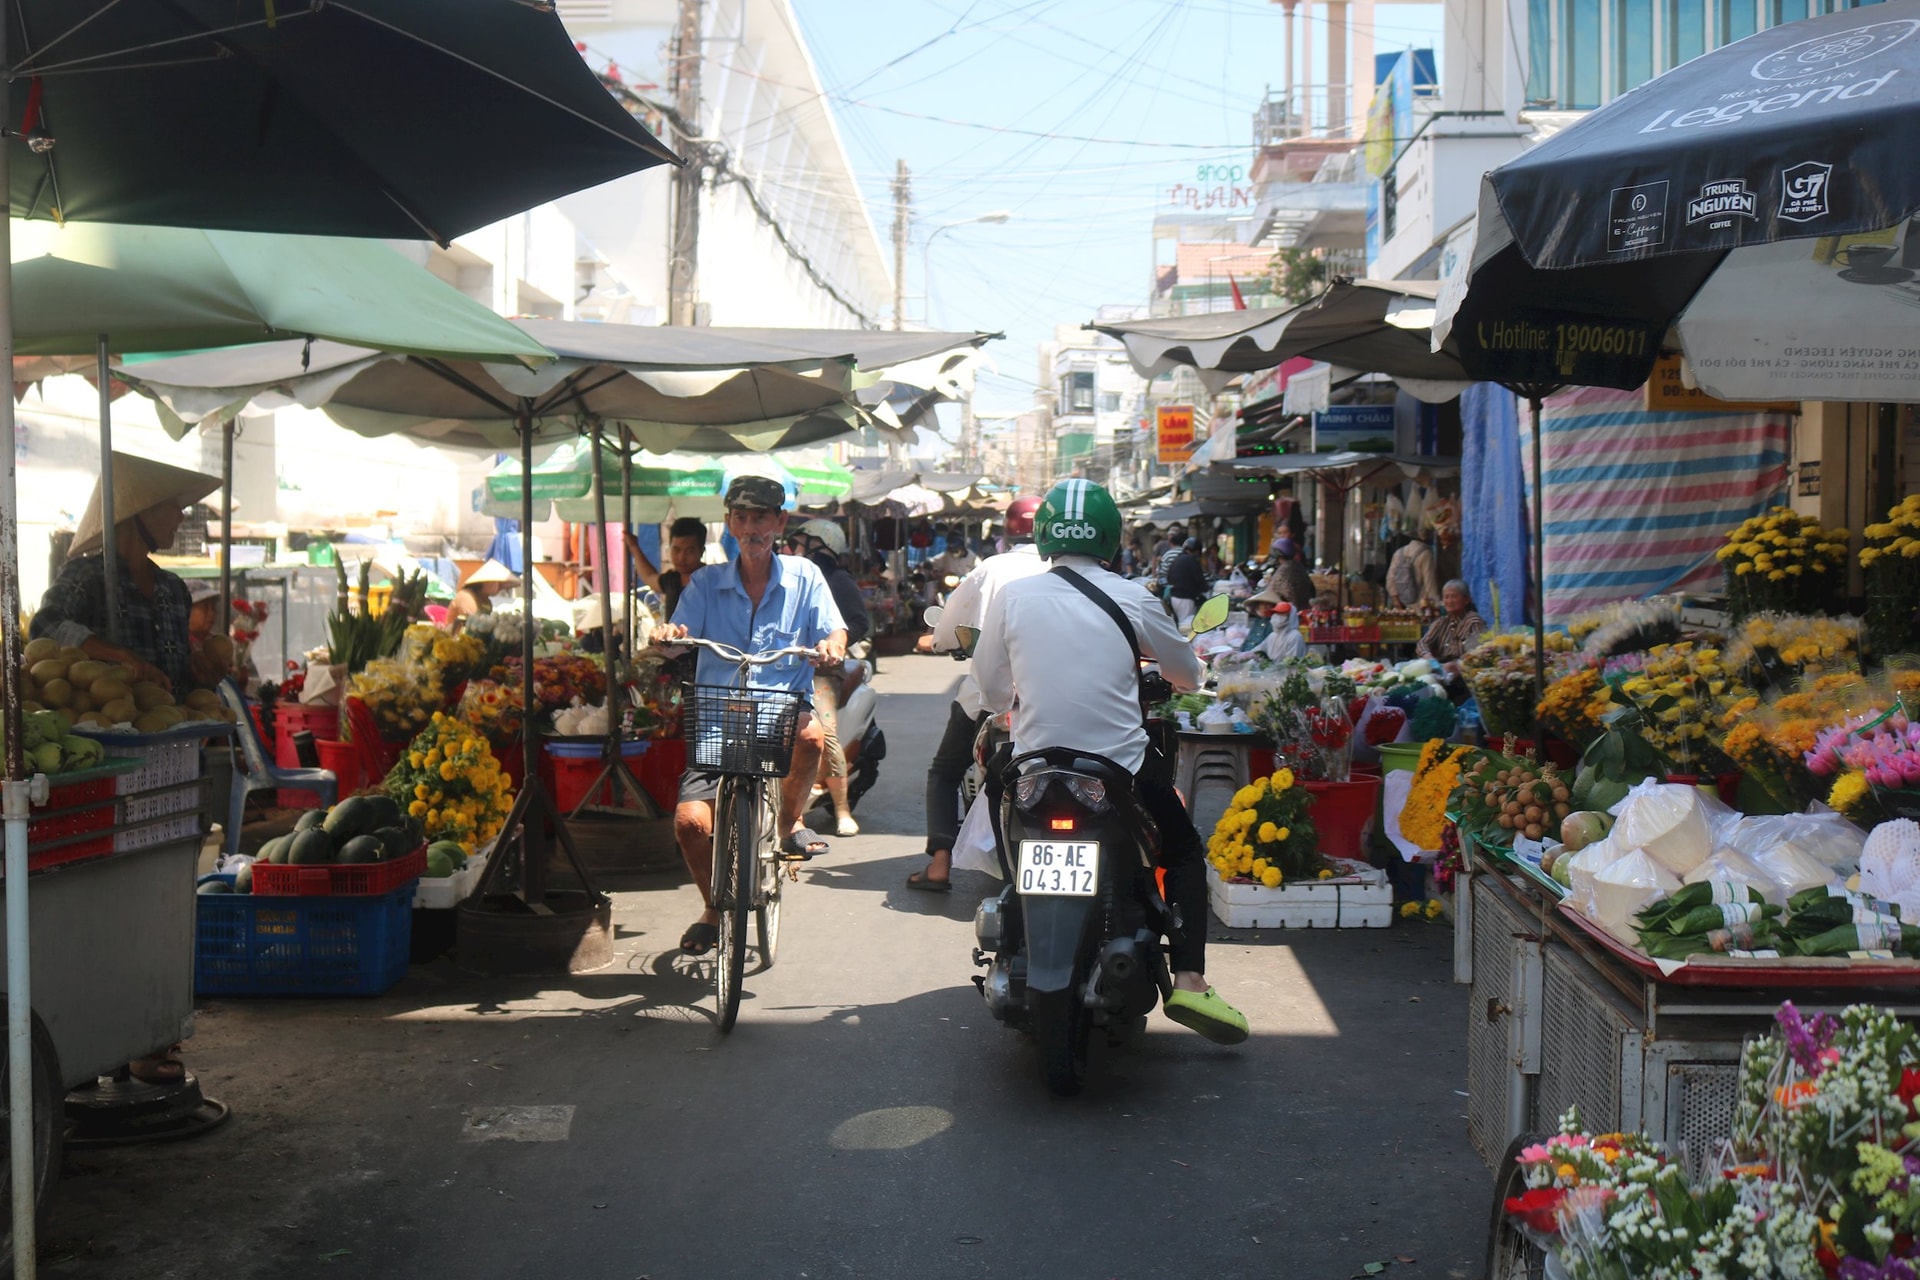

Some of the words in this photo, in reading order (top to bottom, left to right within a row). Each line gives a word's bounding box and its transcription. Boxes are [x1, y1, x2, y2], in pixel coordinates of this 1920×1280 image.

[1637, 68, 1901, 135] Legend
[1705, 183, 1740, 197] TRUNG
[1786, 173, 1825, 199] G7
[1691, 195, 1752, 218] NGUYÊN
[1709, 220, 1732, 230] COFFEE
[1492, 321, 1550, 350] Hotline:
[1556, 324, 1647, 355] 19006011
[1320, 414, 1352, 423] MINH
[1051, 522, 1097, 540] Grab
[1032, 844, 1087, 867] 86-AE
[1022, 869, 1093, 892] 043.12
